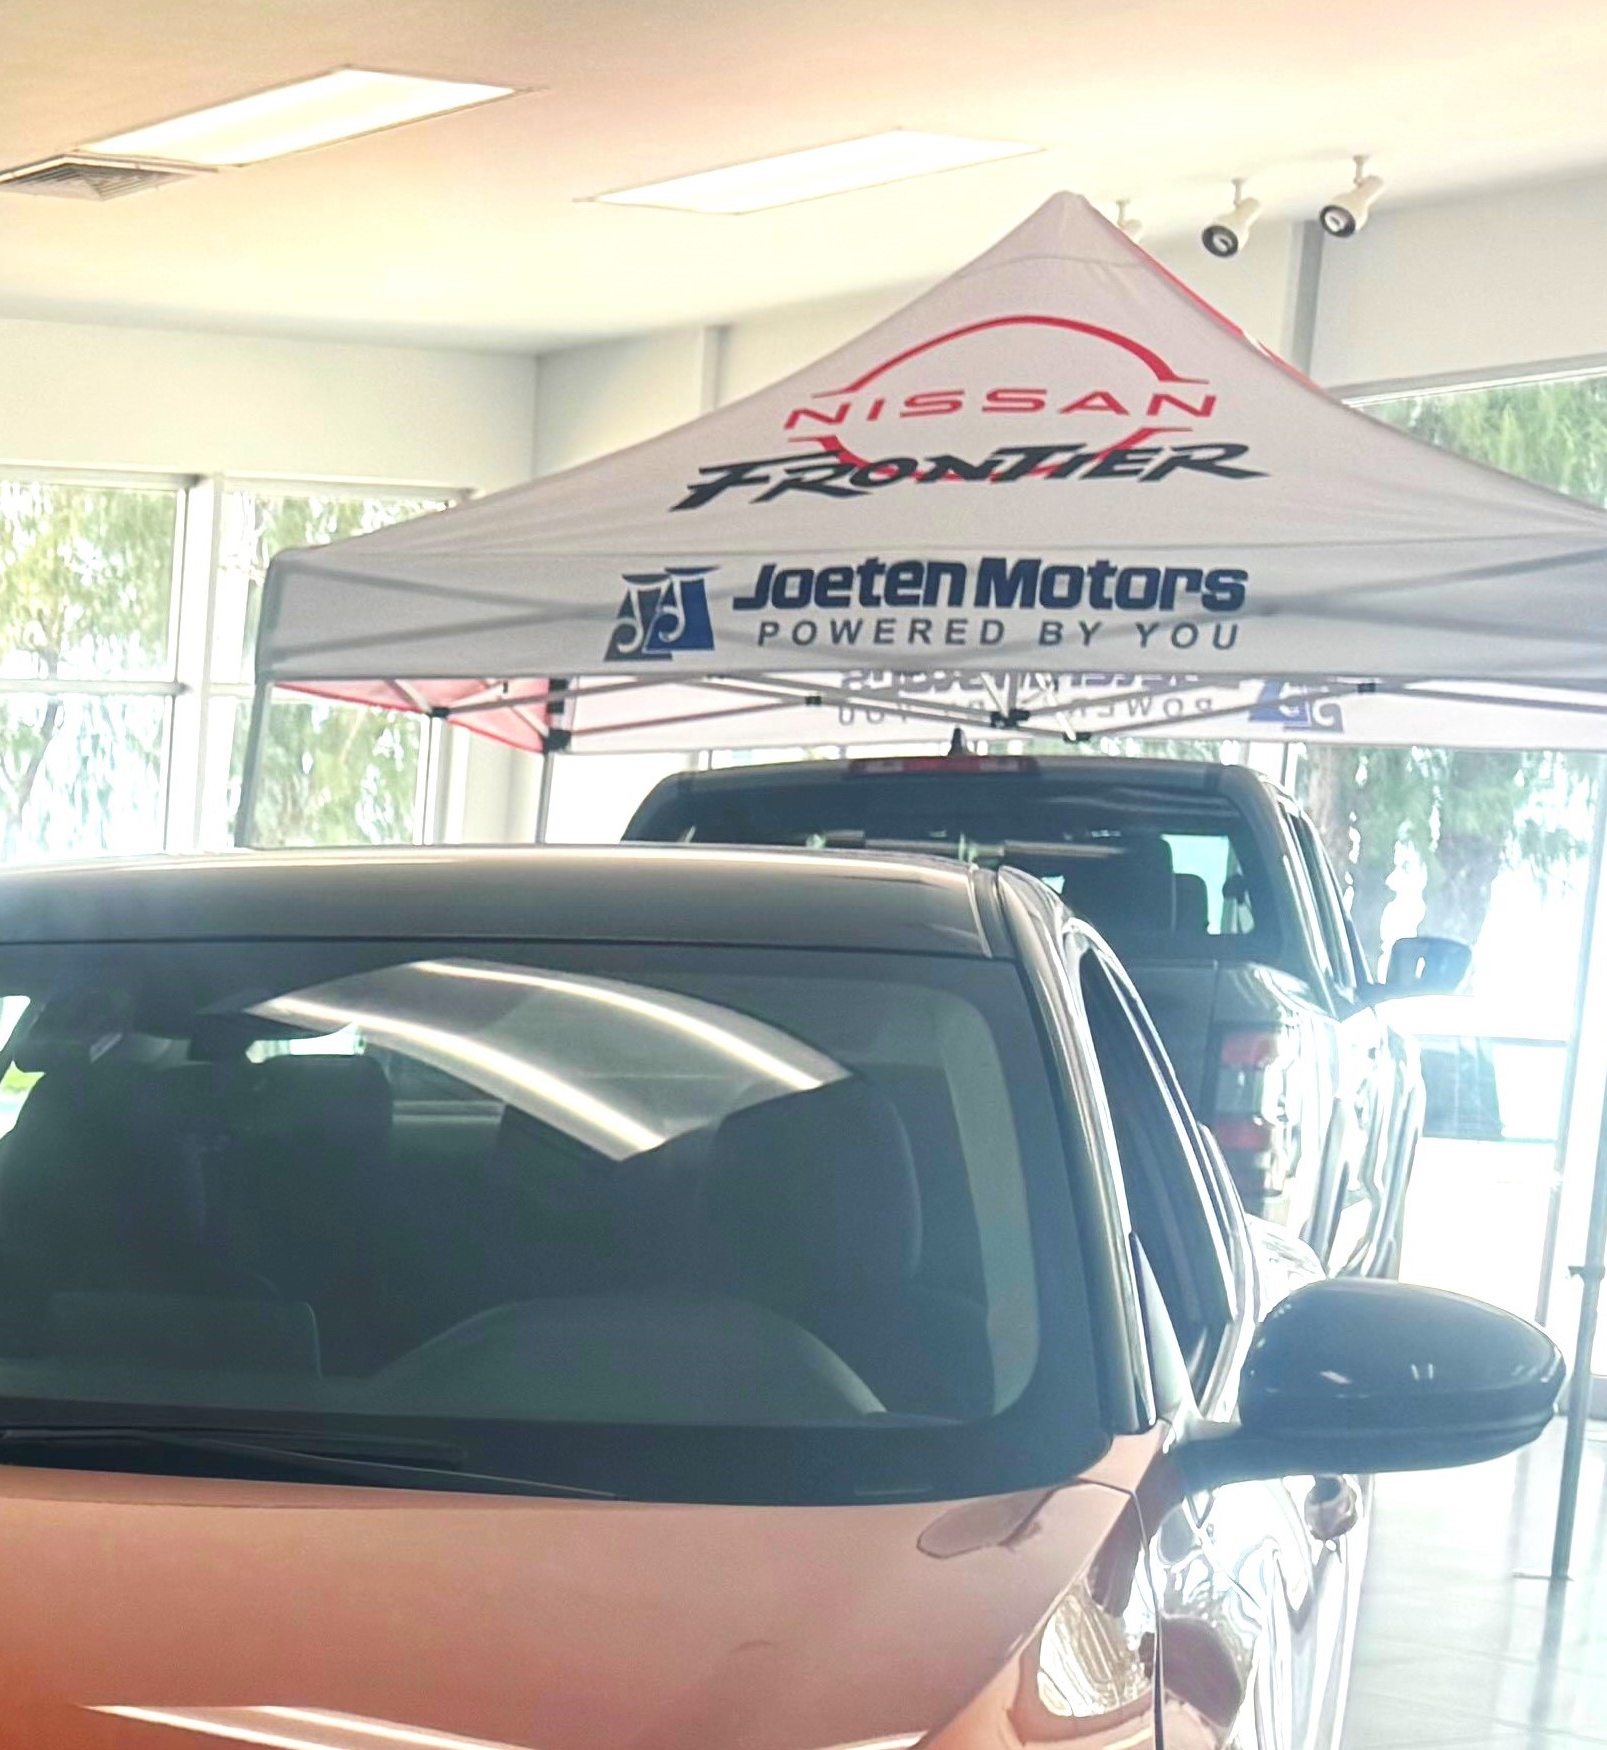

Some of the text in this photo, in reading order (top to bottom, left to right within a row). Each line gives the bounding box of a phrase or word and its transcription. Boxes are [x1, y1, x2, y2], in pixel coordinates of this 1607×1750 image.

[783, 388, 1217, 430] NISSAN
[668, 442, 1272, 512] FRONTIER
[733, 556, 1249, 612] Joeten Motors
[756, 617, 1239, 650] POWERED BY YOU
